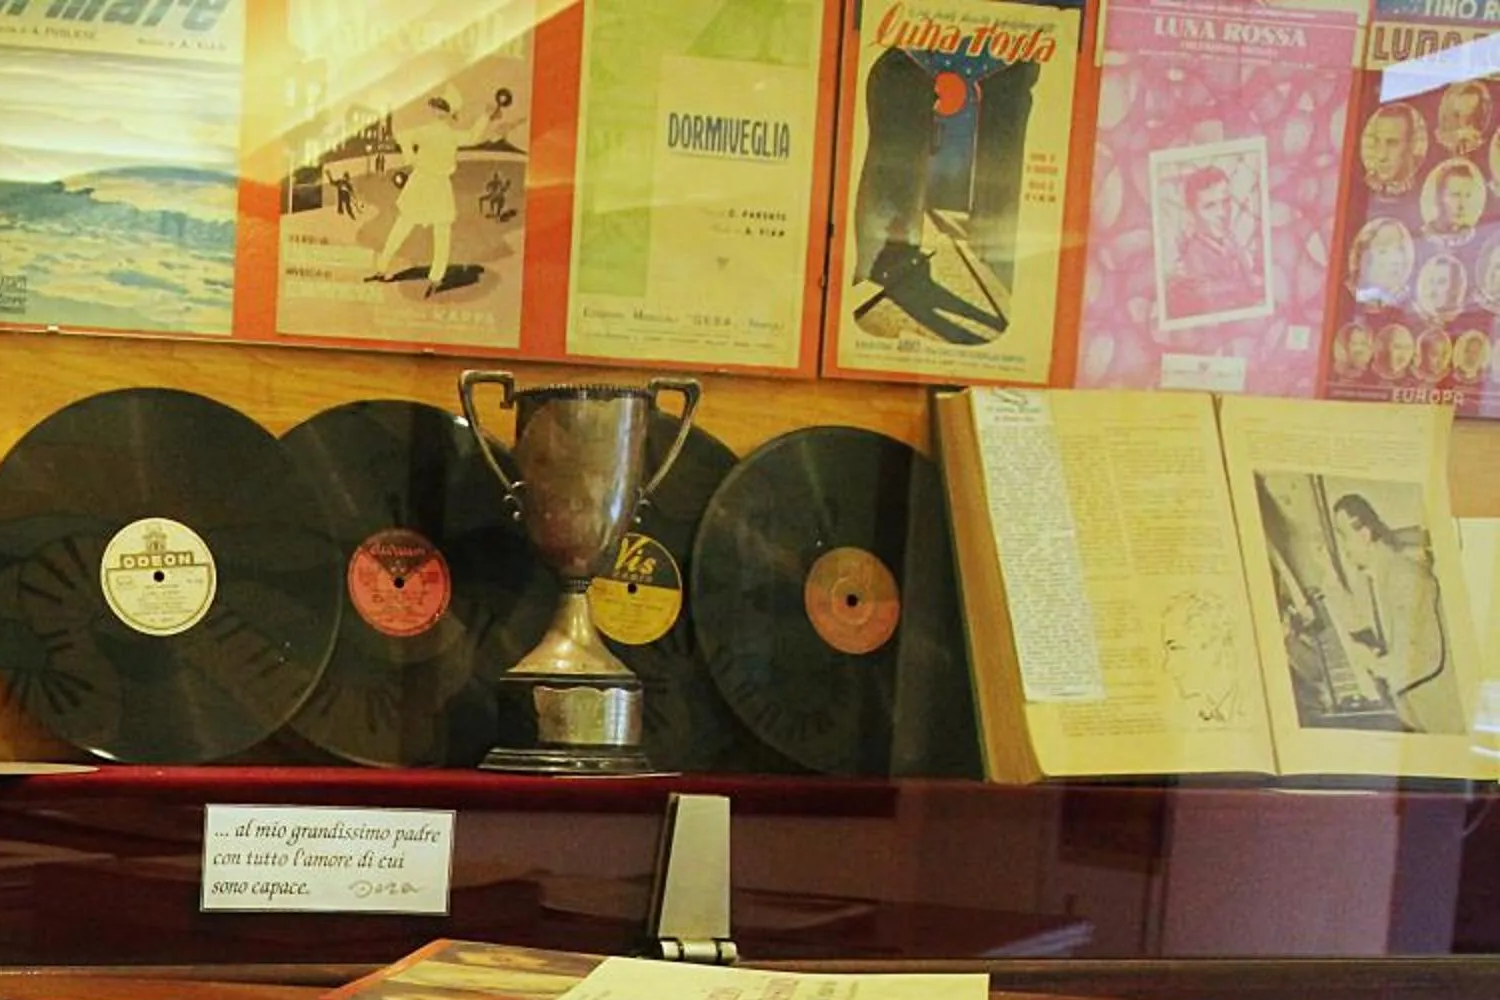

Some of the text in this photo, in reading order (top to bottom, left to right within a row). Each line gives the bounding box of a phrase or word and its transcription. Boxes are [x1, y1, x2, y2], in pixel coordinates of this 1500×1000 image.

[1154, 15, 1217, 40] LUNA
[1223, 21, 1308, 48] ROSSA
[668, 112, 790, 159] DORMIVEGLIA
[123, 553, 192, 569] ODEON
[614, 536, 656, 573] Vis
[235, 820, 251, 838] al
[255, 821, 287, 838] mio
[287, 821, 391, 846] grandissimo
[392, 824, 442, 848] padre
[213, 850, 405, 869] con tutto l'amore di cui
[211, 880, 311, 901] sono capace.
